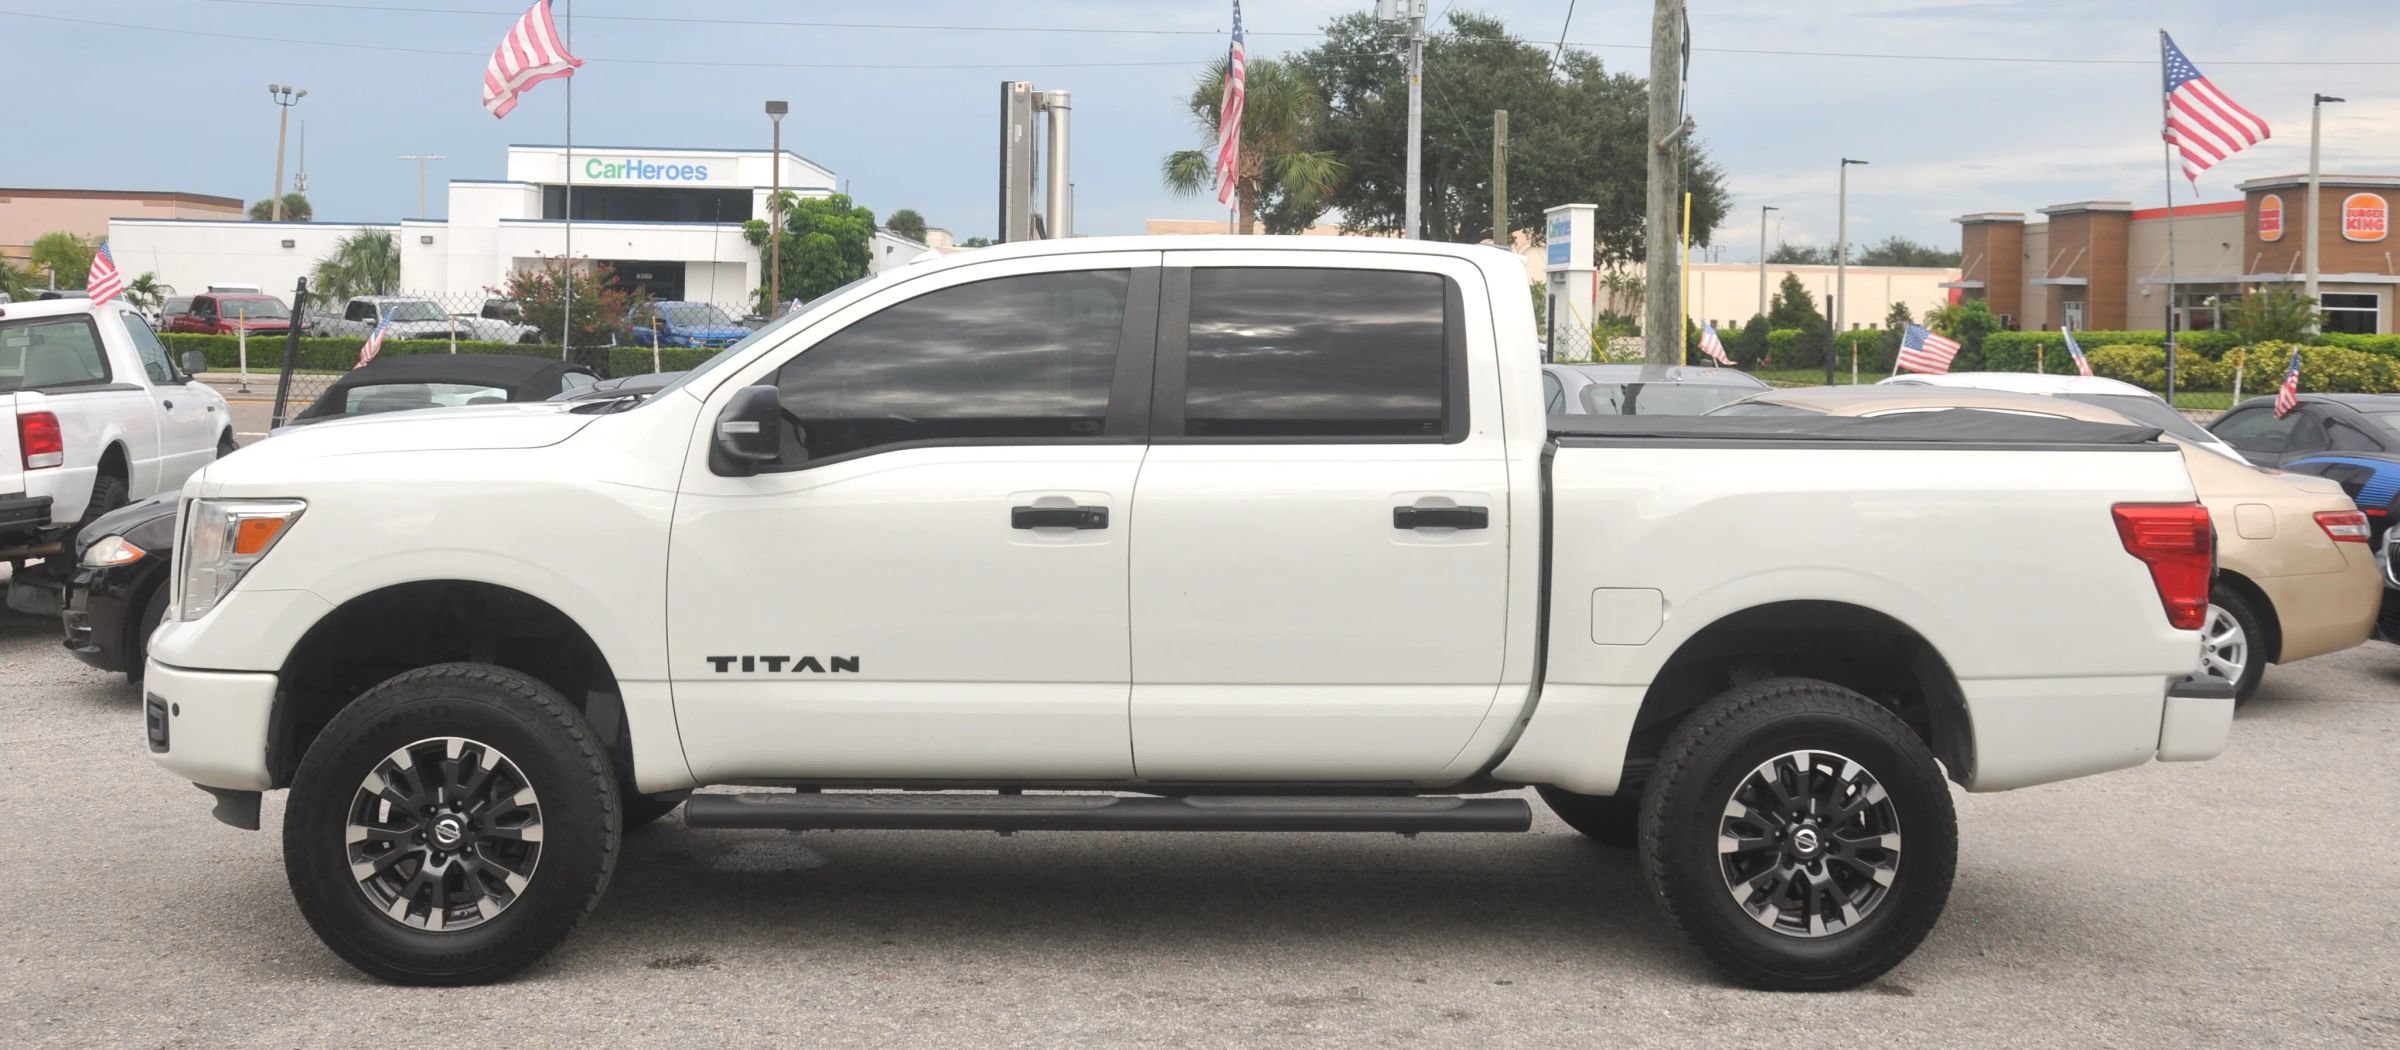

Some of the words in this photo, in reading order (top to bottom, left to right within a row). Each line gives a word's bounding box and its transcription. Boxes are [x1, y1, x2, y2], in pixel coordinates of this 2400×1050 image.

[585, 158, 708, 181] CarHeroes
[2346, 218, 2384, 231] KING
[706, 655, 860, 673] TITAN
